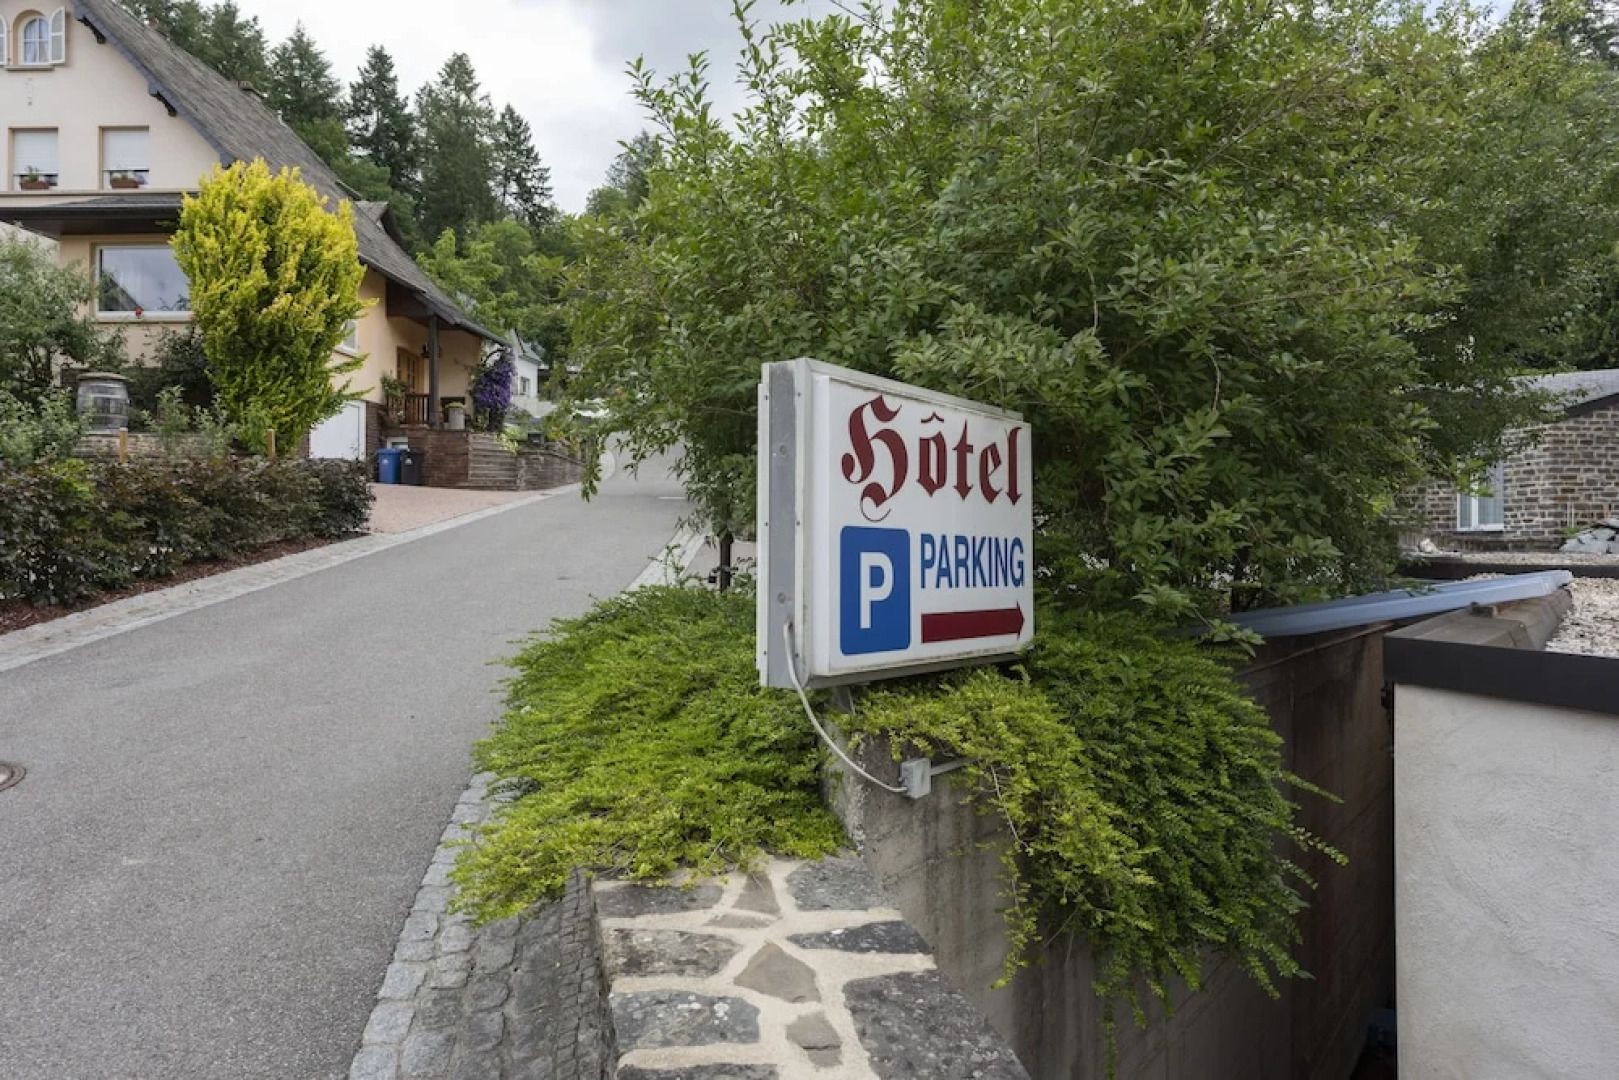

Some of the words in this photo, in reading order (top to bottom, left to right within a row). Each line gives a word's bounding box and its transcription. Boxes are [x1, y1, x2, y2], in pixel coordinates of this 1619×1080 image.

[841, 395, 1022, 522] Hôtel
[860, 551, 894, 629] P
[920, 533, 1024, 589] PARKING
